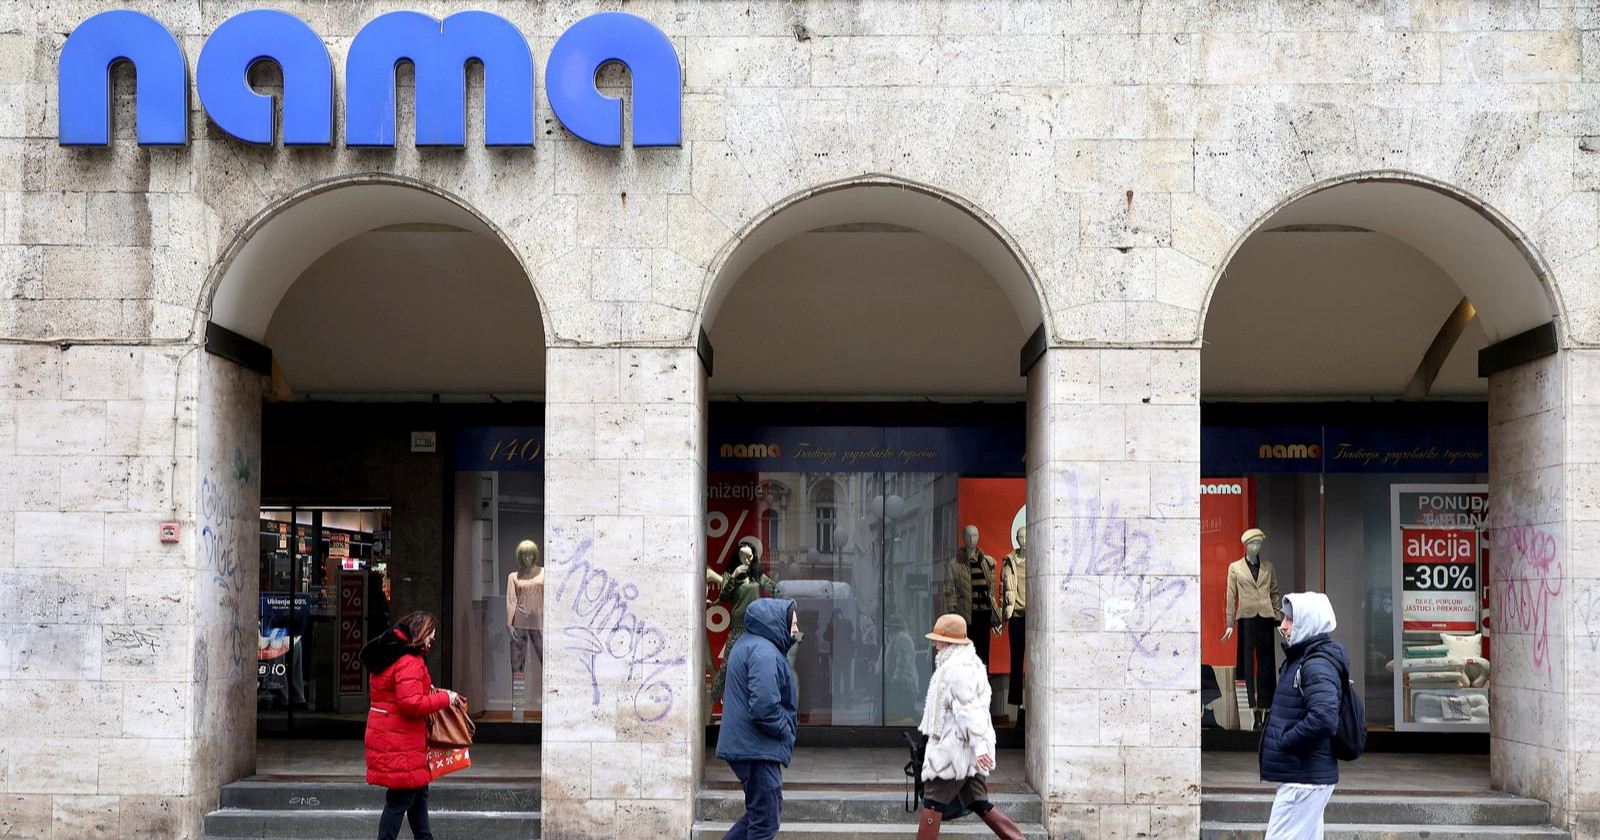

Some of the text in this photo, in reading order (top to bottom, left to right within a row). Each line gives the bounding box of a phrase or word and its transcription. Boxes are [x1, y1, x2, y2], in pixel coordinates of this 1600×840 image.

[58, 9, 682, 149] nama
[489, 438, 541, 461] 140
[720, 443, 781, 459] nama
[1259, 443, 1323, 459] nama
[1200, 483, 1242, 494] nama
[1407, 533, 1471, 562] akcija
[1405, 565, 1473, 589] -30%
